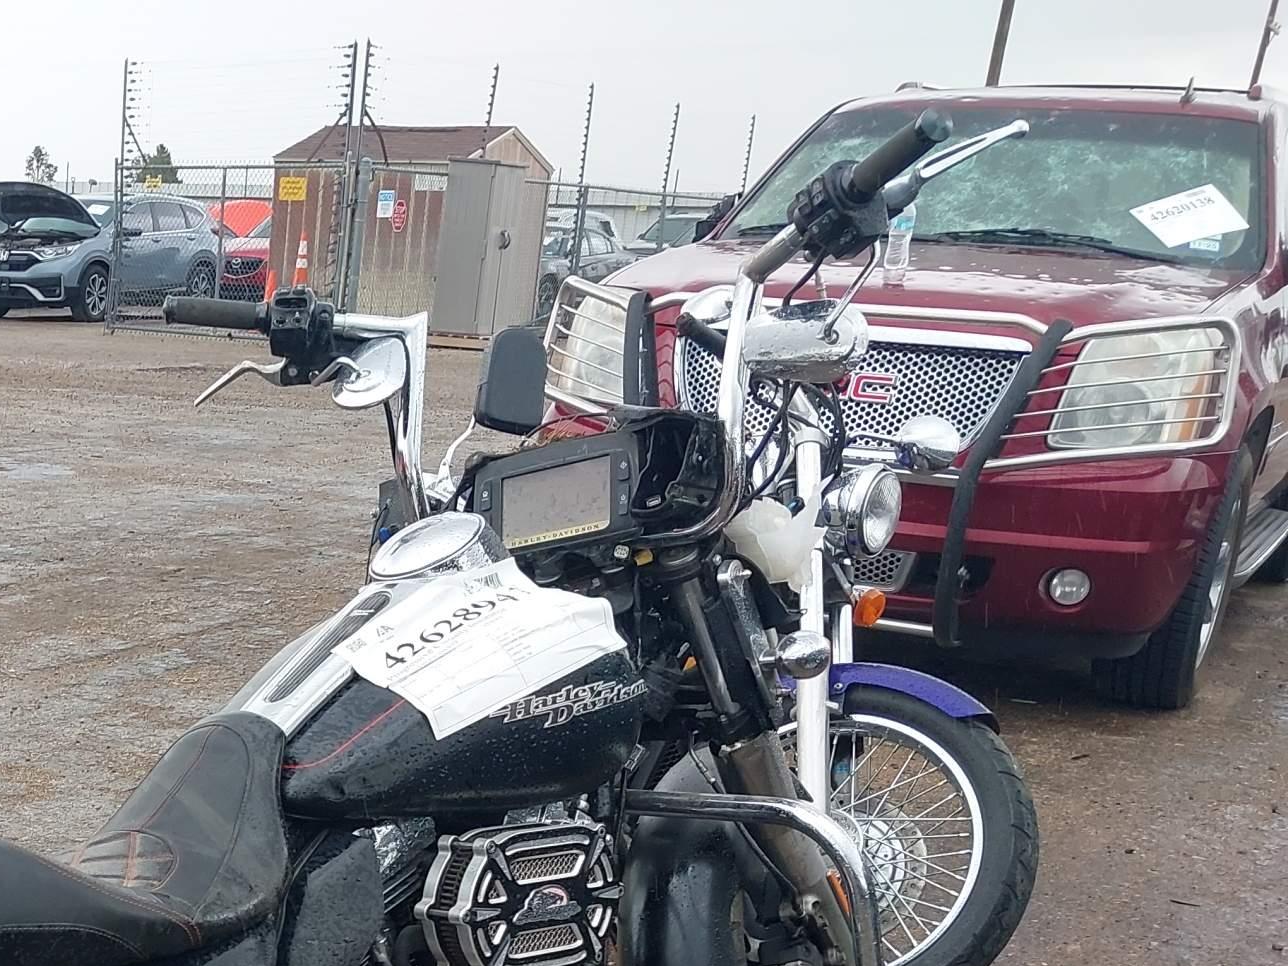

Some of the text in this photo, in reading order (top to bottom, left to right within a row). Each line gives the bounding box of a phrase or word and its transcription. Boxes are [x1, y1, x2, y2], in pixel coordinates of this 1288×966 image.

[1149, 196, 1215, 222] 42620138
[511, 523, 600, 547] HARLEY-DAVIDSON
[489, 681, 616, 724] Harley
[544, 679, 648, 729] Davidson
